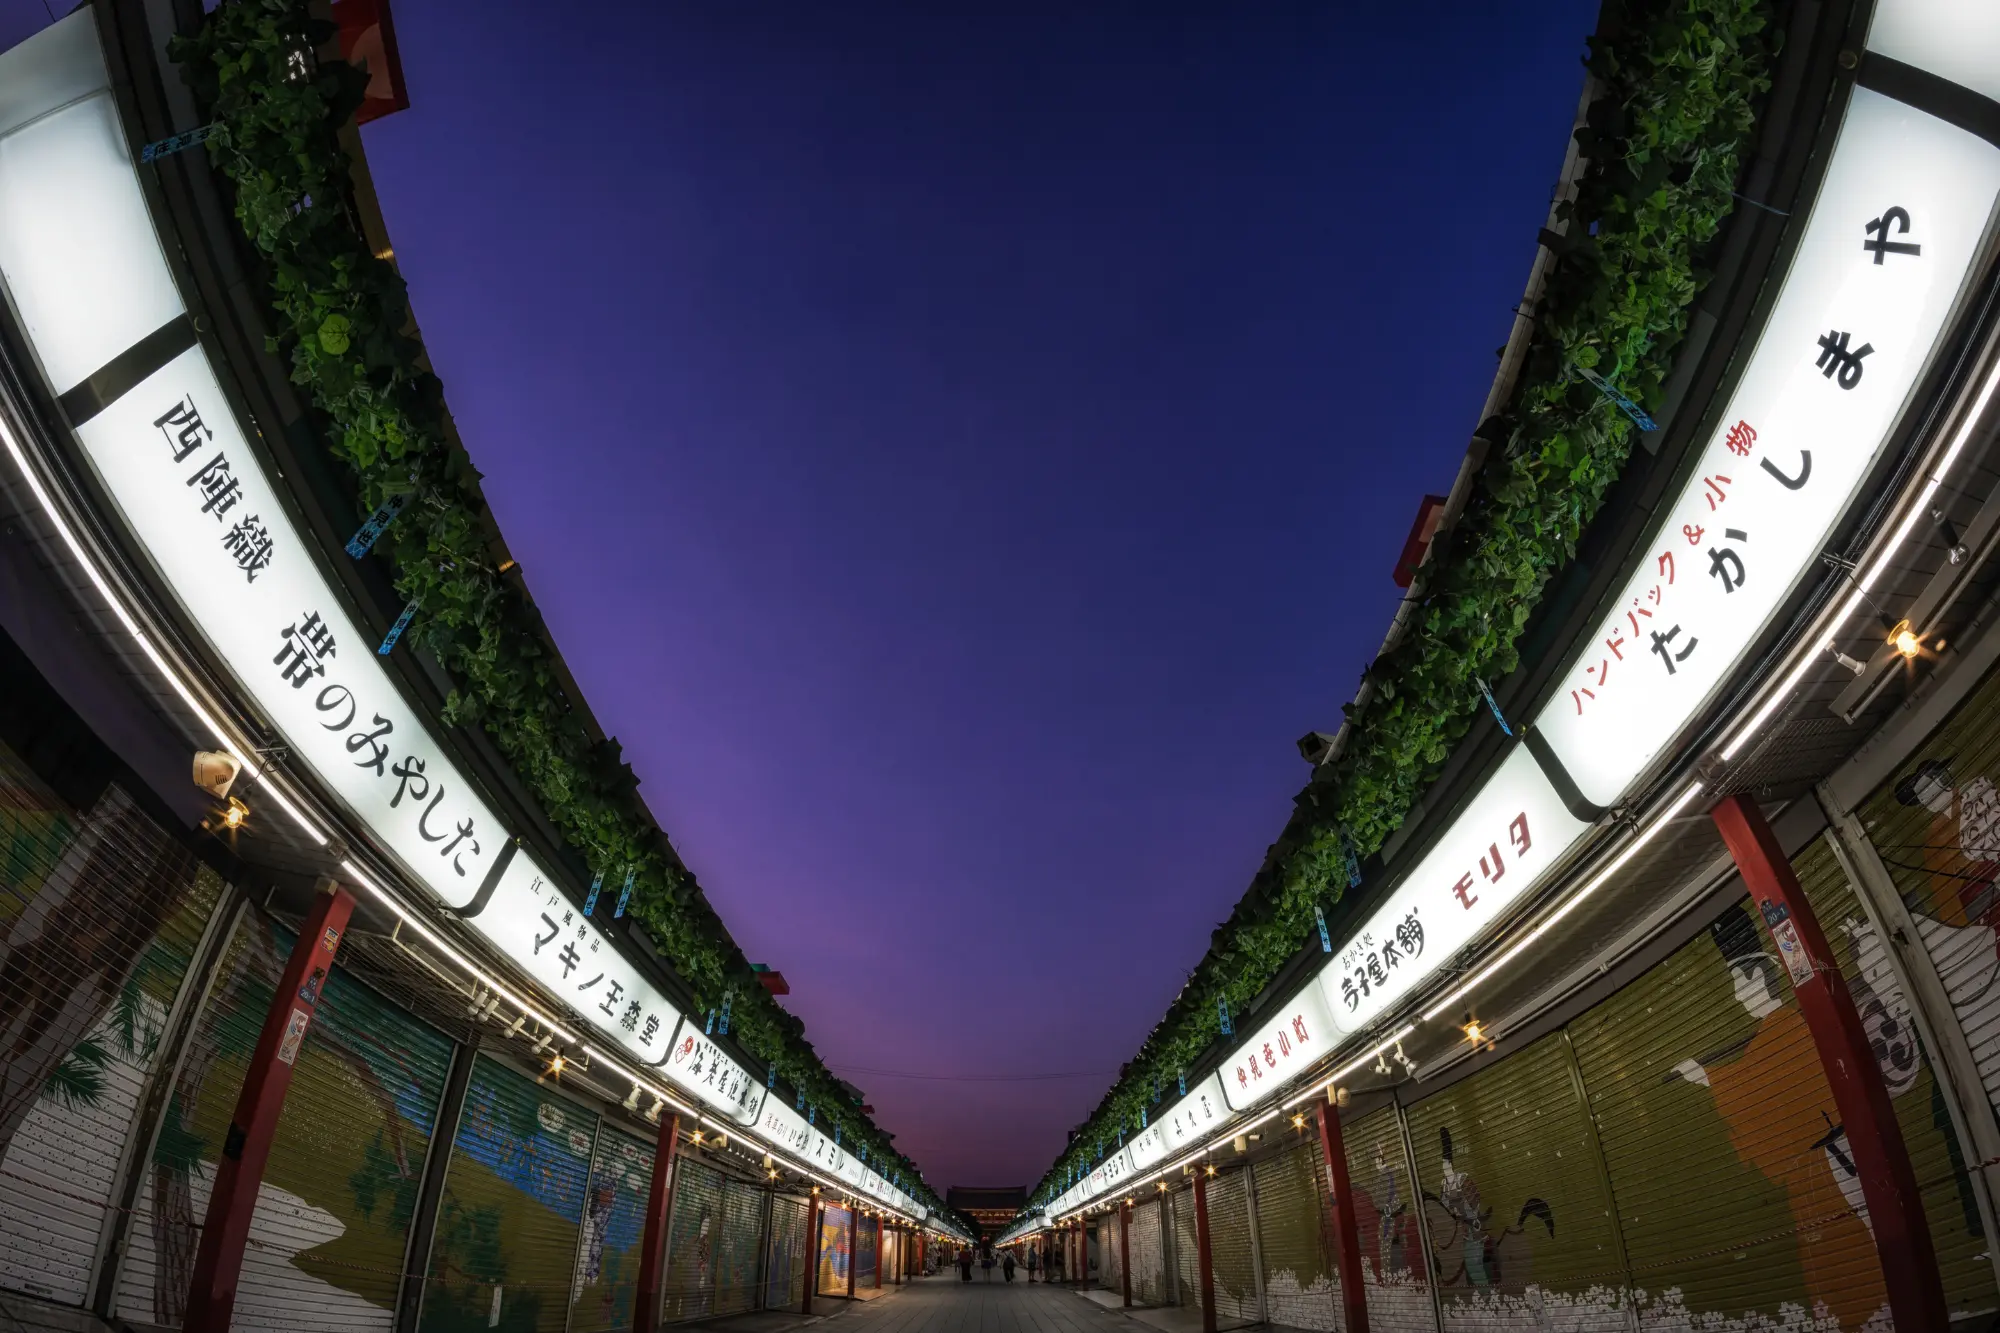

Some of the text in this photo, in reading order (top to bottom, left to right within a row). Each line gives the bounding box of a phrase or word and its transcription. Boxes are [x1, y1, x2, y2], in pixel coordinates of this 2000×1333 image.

[153, 392, 276, 584] 西陣織
[1649, 205, 1922, 676] たかしまや
[1682, 523, 1706, 546] &
[1703, 419, 1759, 513] 小物
[357, 493, 404, 548] 仲見世
[272, 609, 484, 878] 帯のみやした
[530, 875, 601, 955] 江戸風物品
[1452, 811, 1532, 911] モリタ
[533, 911, 661, 1048] マキノ玉森堂
[1236, 1013, 1311, 1090] 仲見世小町
[815, 1138, 845, 1171] スミレ
